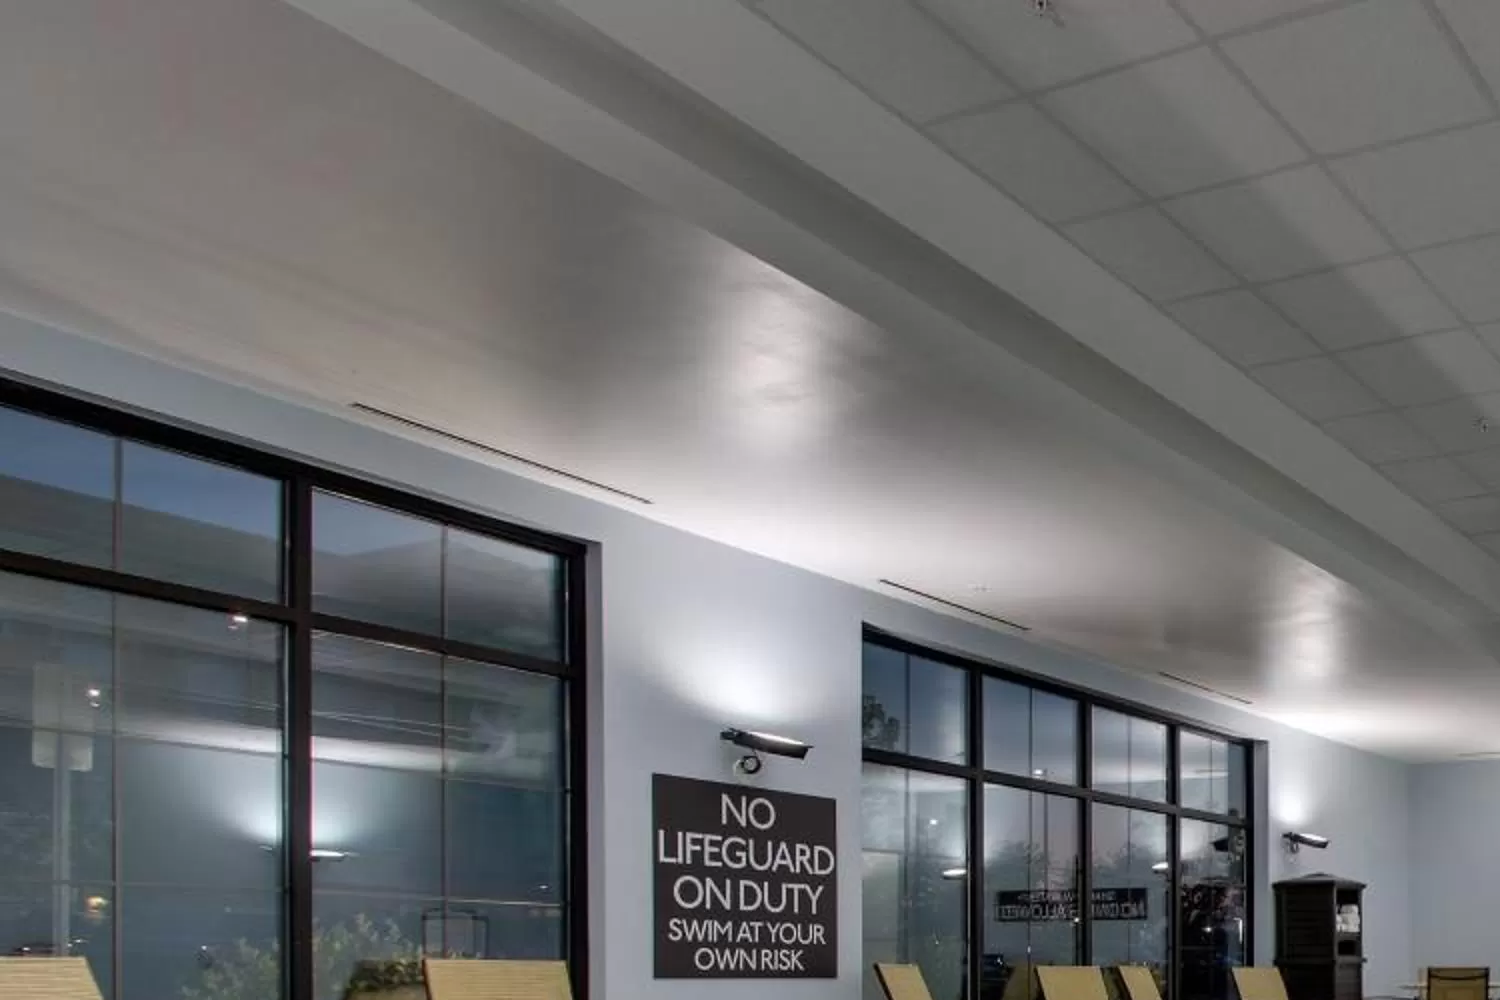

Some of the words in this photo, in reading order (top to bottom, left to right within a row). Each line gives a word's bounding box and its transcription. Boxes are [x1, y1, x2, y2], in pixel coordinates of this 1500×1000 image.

[721, 793, 776, 830] NO
[658, 829, 835, 875] LIFEGUARD
[673, 875, 731, 911] ON
[739, 880, 824, 915] DUTY
[668, 918, 732, 943] SWIM
[736, 921, 763, 943] AT
[767, 922, 826, 945] YOUR
[694, 947, 757, 971] OWN
[761, 949, 804, 971] RISK
